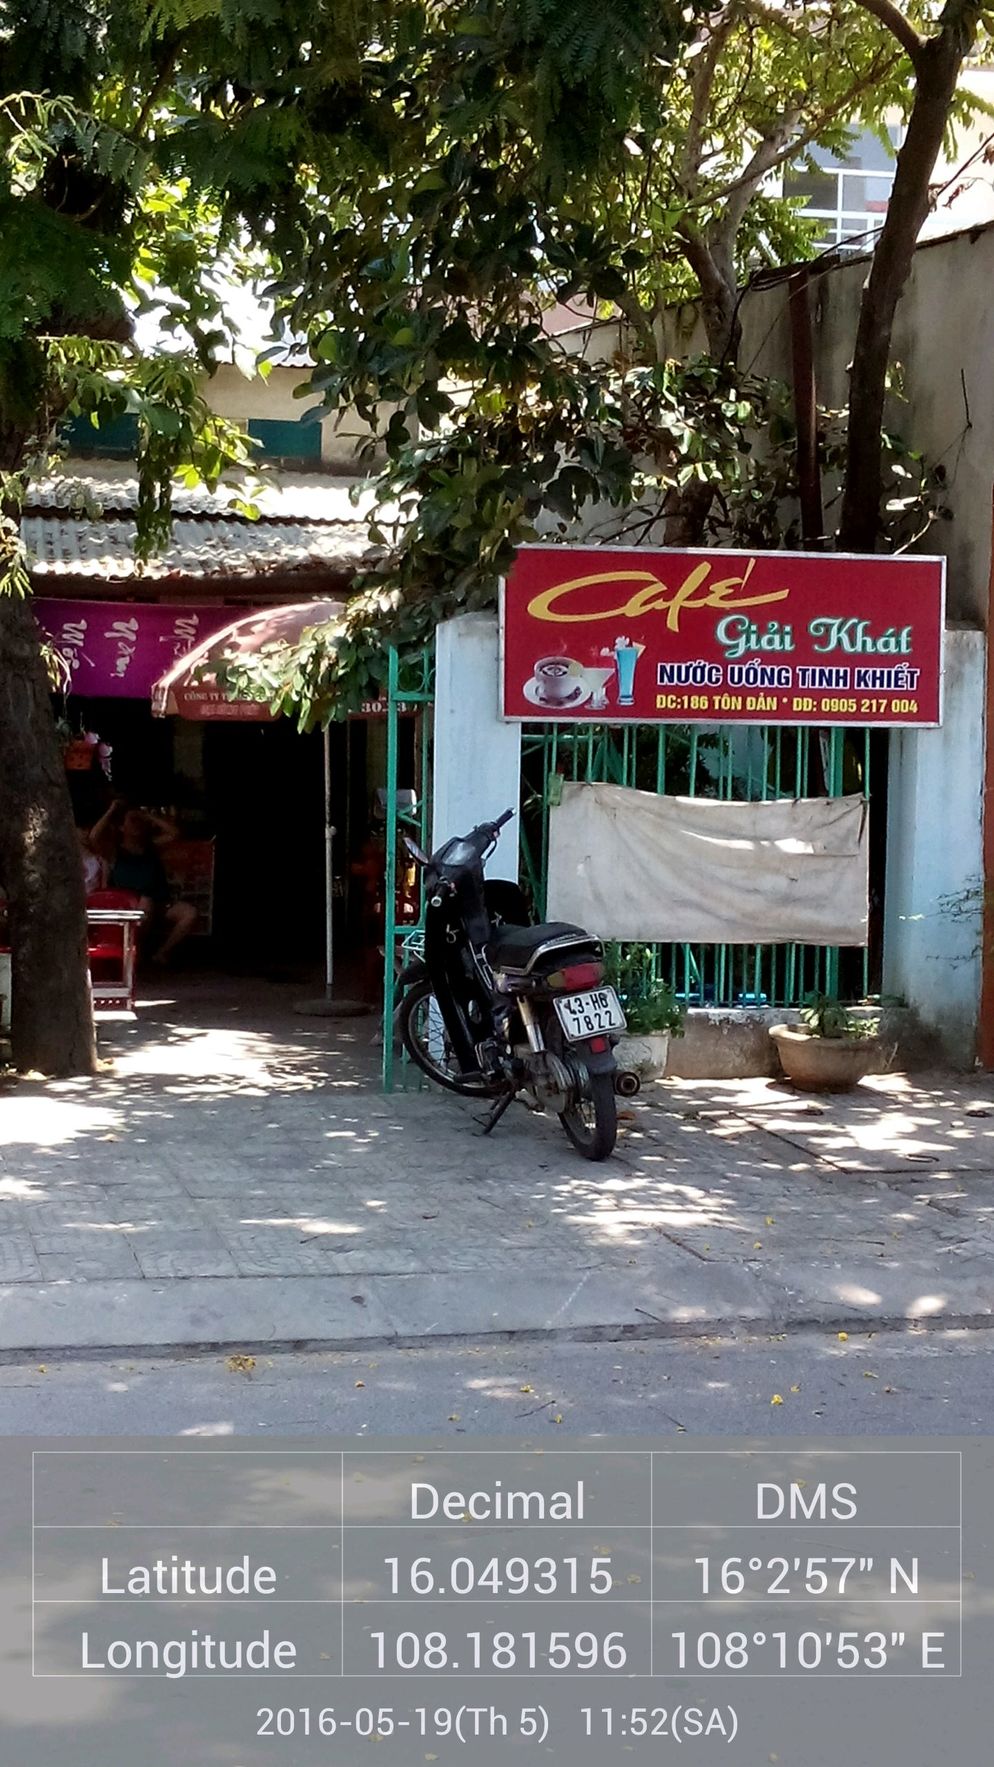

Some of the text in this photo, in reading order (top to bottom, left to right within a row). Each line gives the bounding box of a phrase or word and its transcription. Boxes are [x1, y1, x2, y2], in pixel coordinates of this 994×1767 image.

[526, 557, 790, 633] Café
[716, 614, 913, 659] Giải Khát
[657, 658, 920, 691] NƯỚC UỐNG TINH KHIẾT
[713, 692, 742, 711] TÔN
[821, 698, 857, 713] 0905
[860, 698, 887, 713] 217
[891, 699, 918, 713] 004
[572, 1011, 616, 1034] 7822
